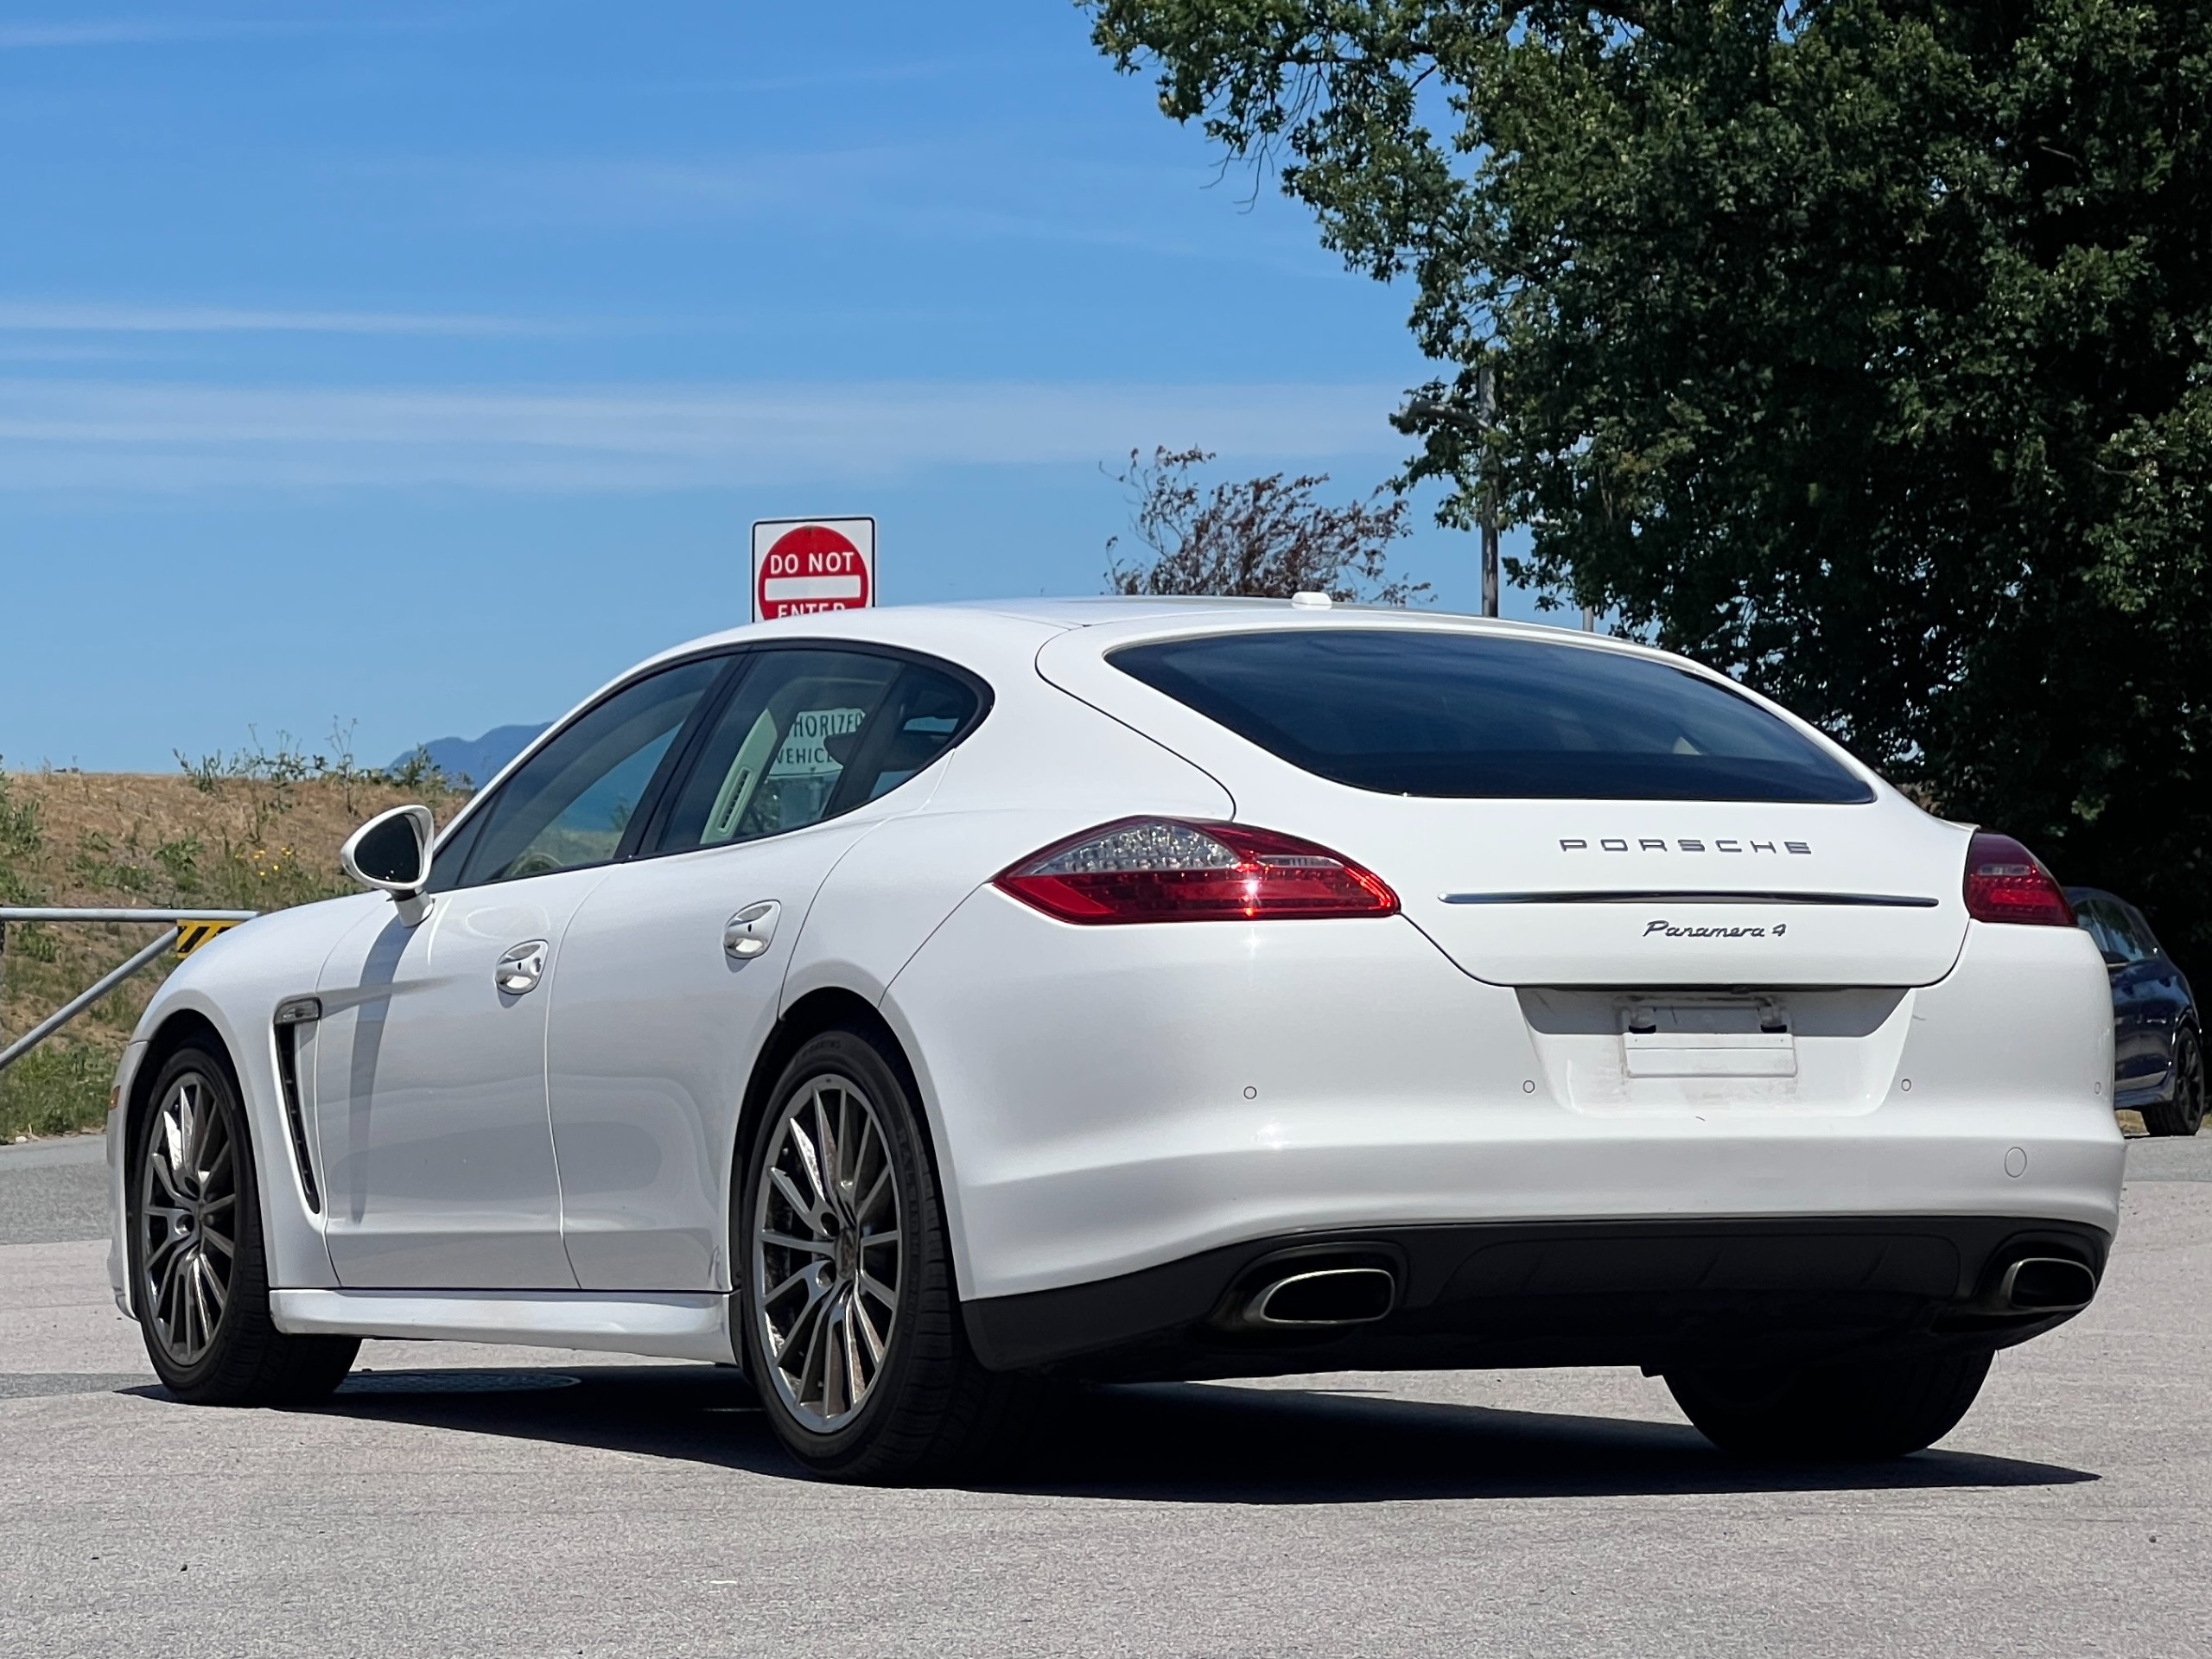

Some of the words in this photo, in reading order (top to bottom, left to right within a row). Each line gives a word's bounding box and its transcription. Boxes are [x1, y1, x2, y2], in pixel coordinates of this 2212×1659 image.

[771, 554, 798, 574] DO
[808, 552, 854, 572] NOT
[1559, 838, 1812, 855] PORSCHE
[1643, 920, 1765, 938] Panamera
[1771, 923, 1787, 937] 4
